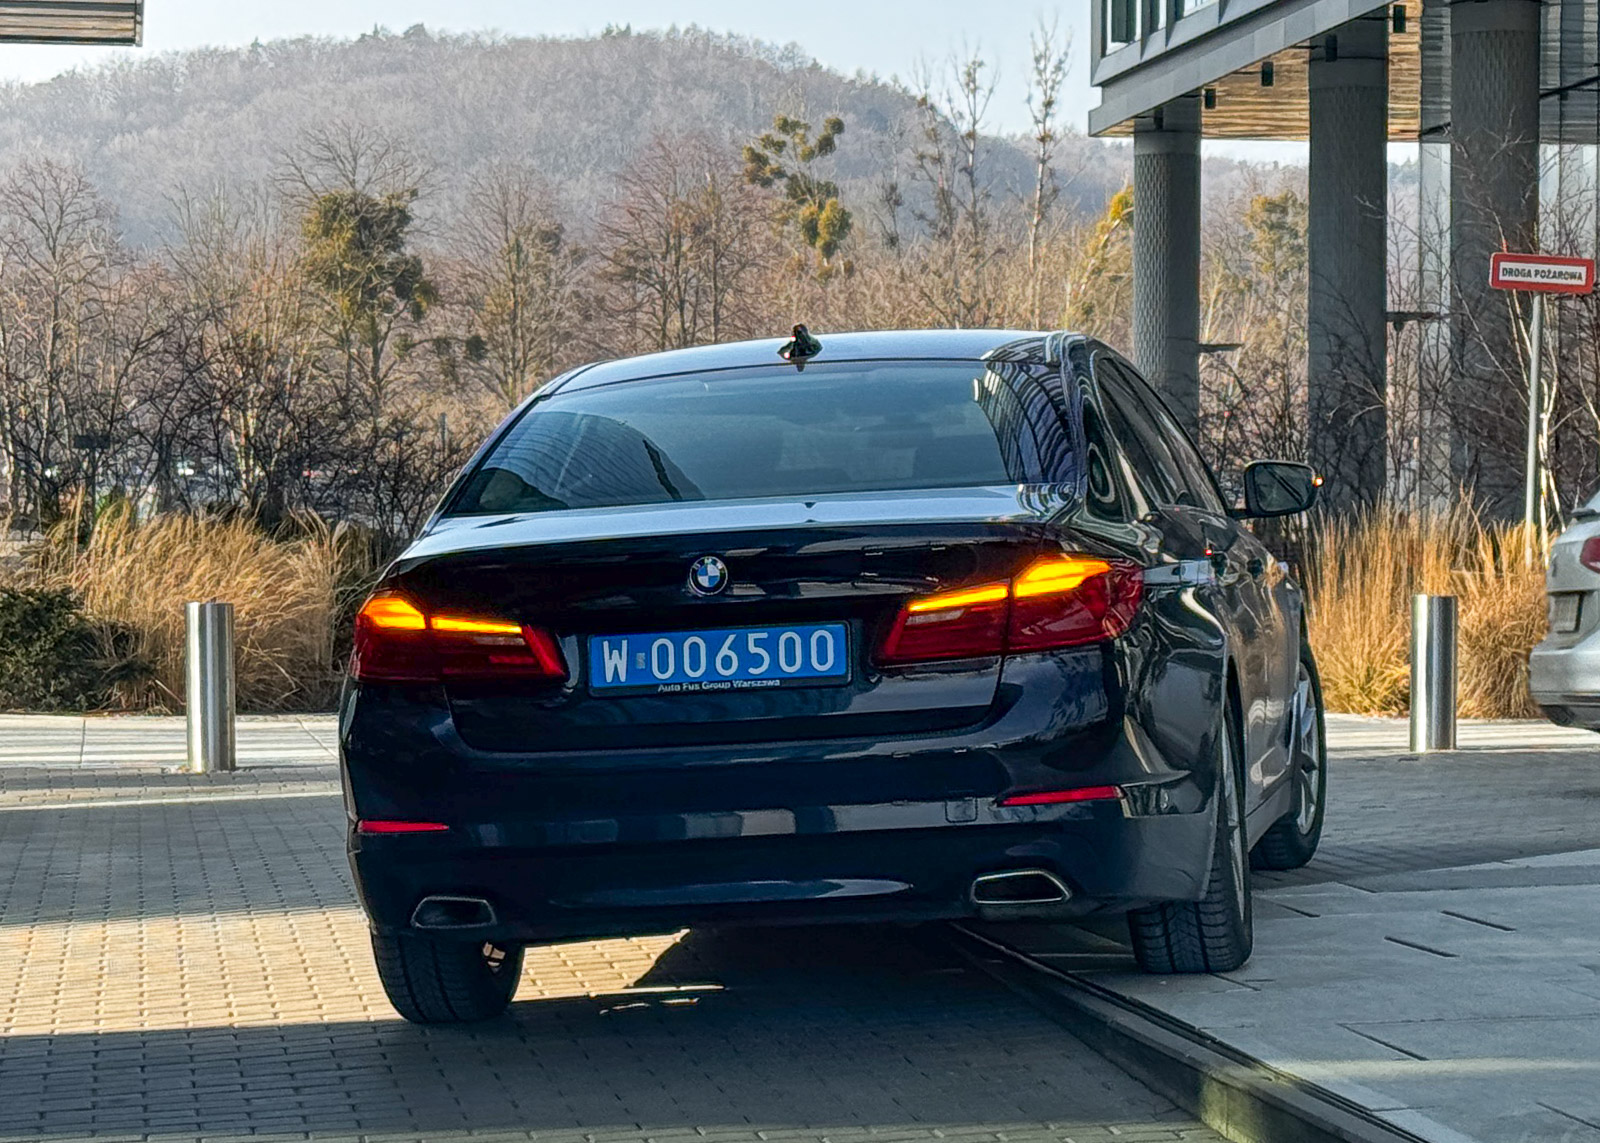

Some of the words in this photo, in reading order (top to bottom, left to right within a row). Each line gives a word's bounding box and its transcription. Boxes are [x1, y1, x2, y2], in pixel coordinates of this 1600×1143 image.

[1502, 267, 1532, 278] DROGA
[1534, 269, 1583, 281] POŻAROWA
[603, 639, 628, 683] W
[651, 629, 835, 680] 006500
[658, 683, 681, 692] Auto
[682, 682, 700, 691] Fus
[701, 681, 731, 690] Group
[732, 679, 780, 688] Warszawa
